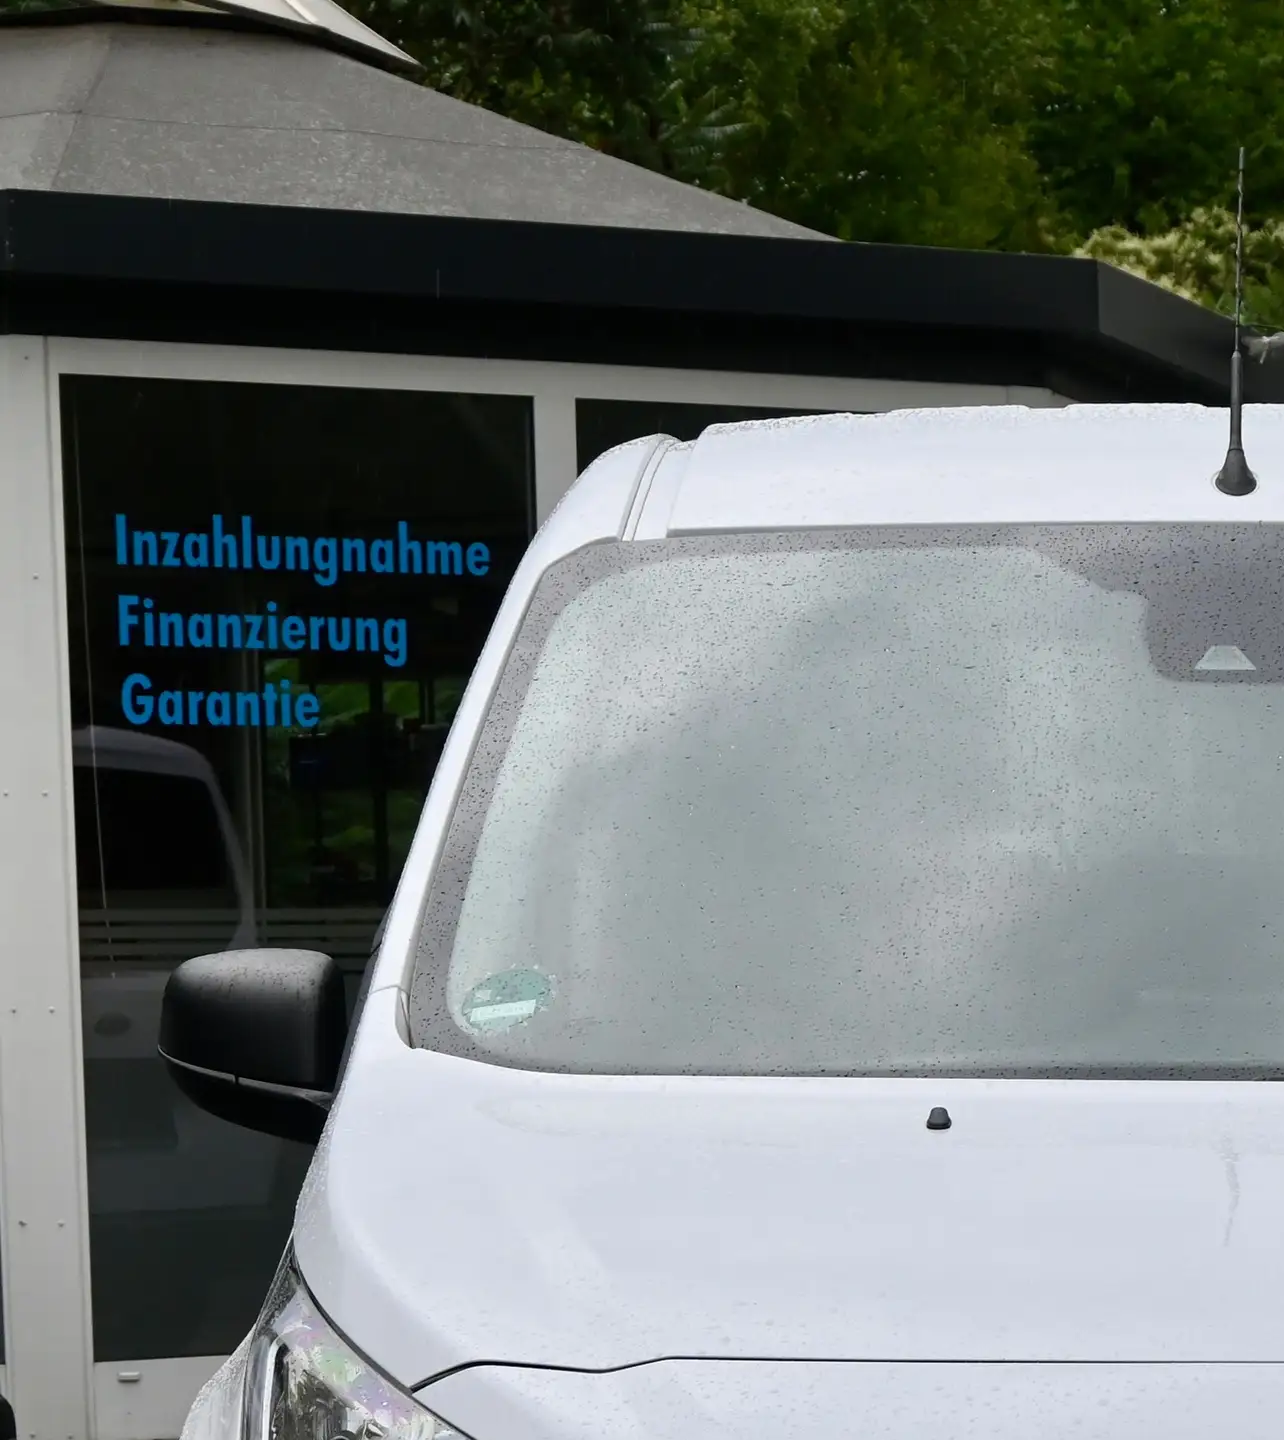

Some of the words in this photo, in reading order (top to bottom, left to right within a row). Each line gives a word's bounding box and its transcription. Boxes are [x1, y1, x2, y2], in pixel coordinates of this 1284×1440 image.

[115, 514, 490, 586] Inzahlungnahme
[118, 594, 408, 667] Finanzierung
[121, 673, 320, 728] Garantie
